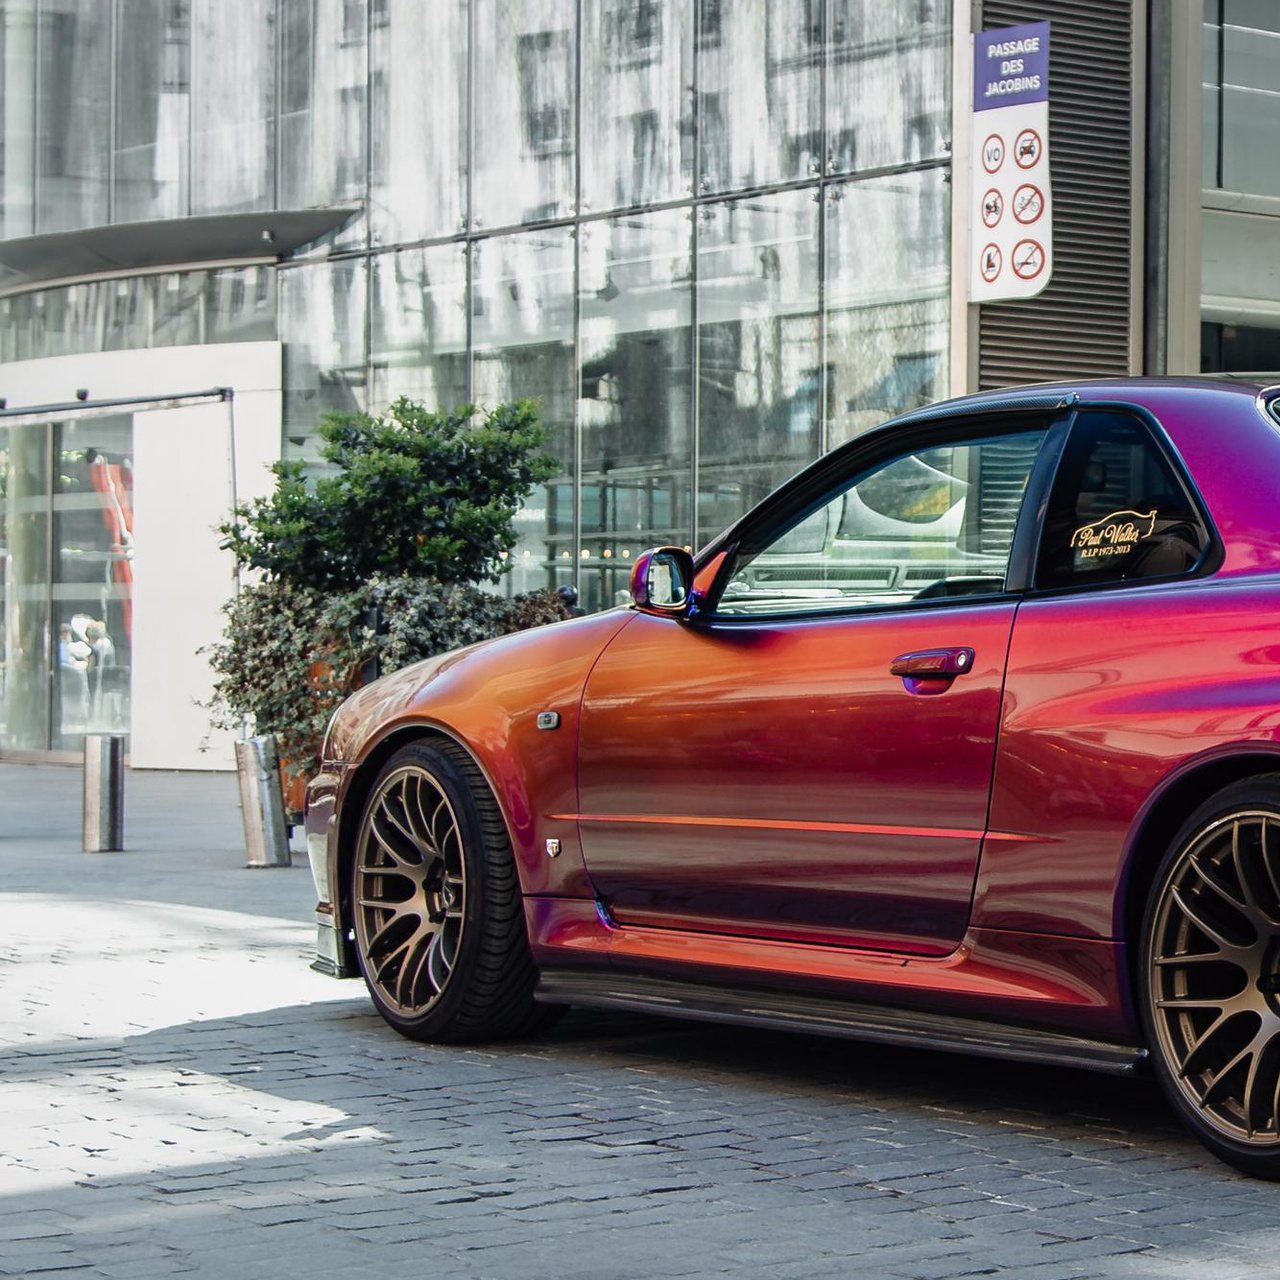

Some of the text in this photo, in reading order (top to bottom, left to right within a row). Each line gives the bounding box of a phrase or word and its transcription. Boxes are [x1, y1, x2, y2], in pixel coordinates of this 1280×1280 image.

[987, 37, 1040, 59] PASSAGE
[1000, 58, 1025, 75] DES
[984, 75, 1041, 96] JACOBINS
[1078, 522, 1140, 547] Paul Walker
[1098, 545, 1131, 556] 1973-2013
